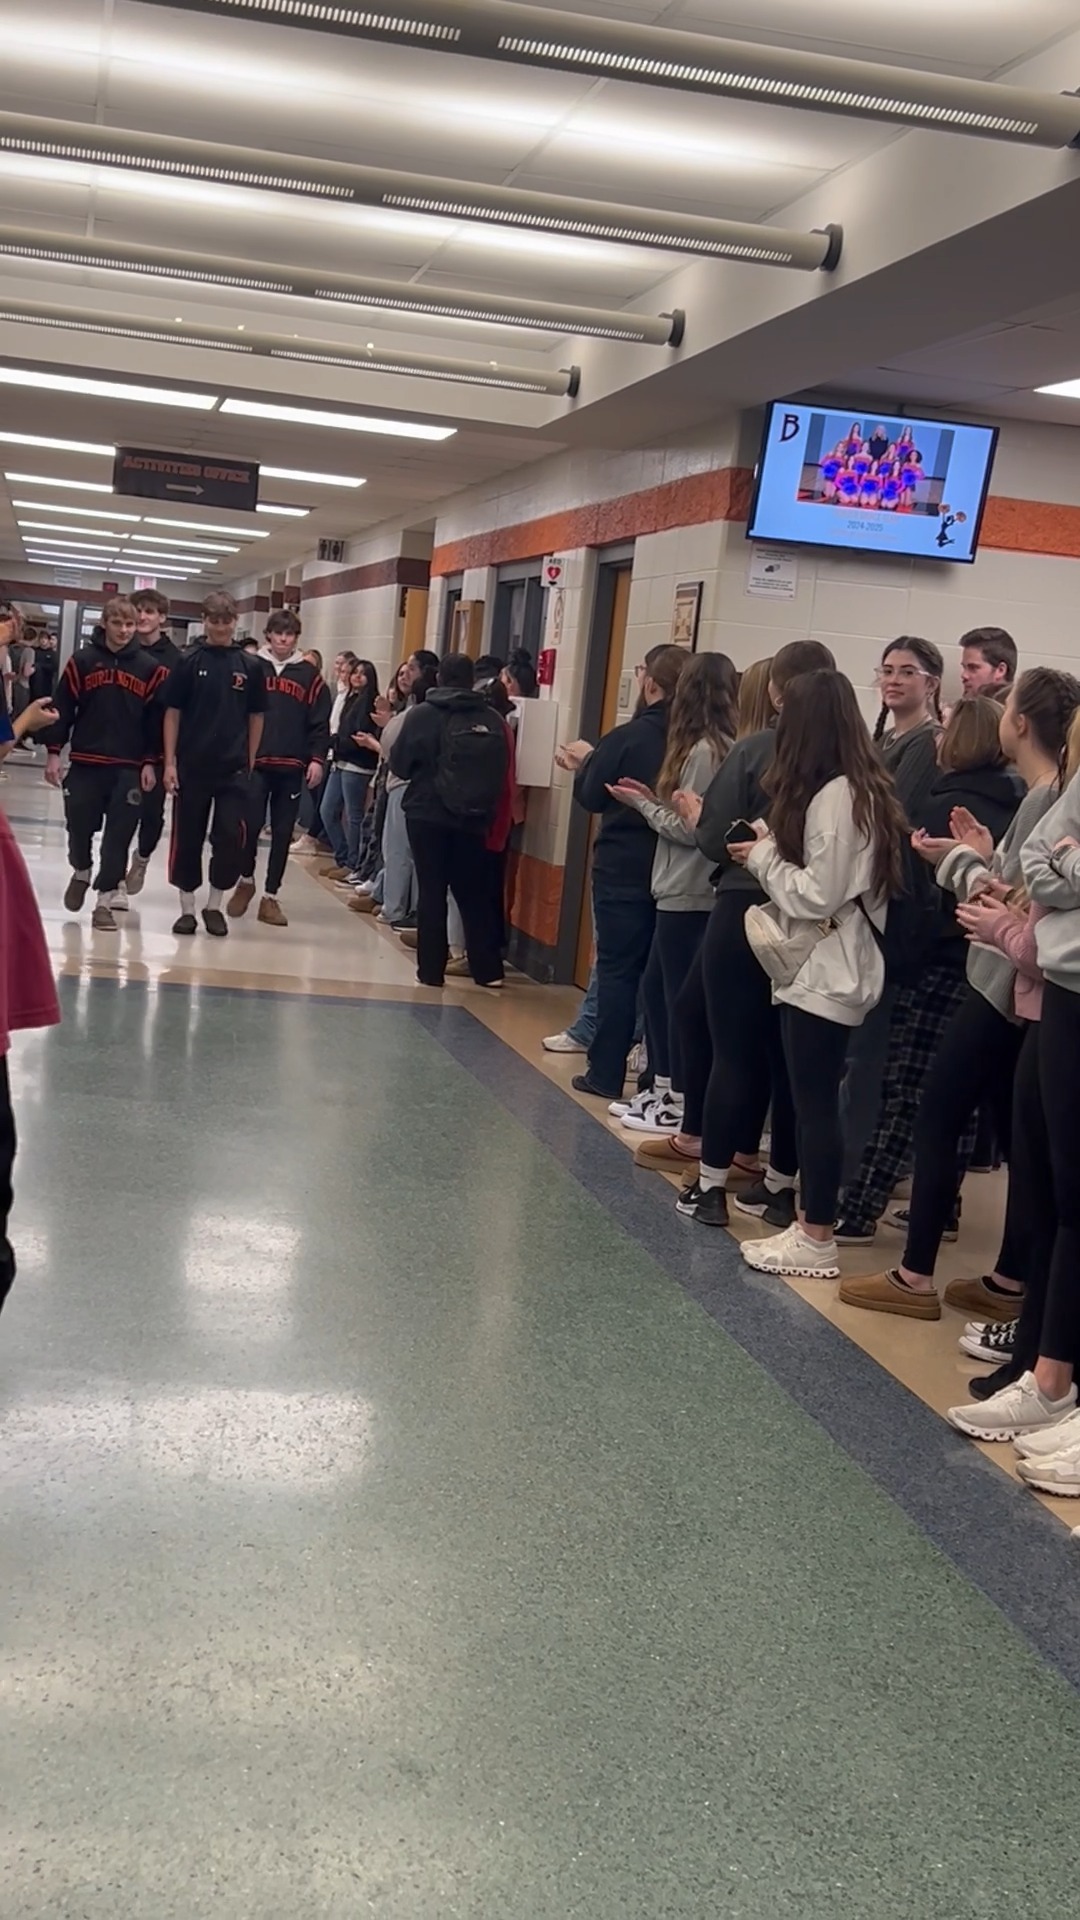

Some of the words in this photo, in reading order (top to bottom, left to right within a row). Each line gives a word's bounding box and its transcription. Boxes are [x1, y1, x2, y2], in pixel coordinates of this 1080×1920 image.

[779, 413, 800, 442] B
[123, 455, 202, 477] ACTIVITIES
[203, 465, 250, 483] OFFICE
